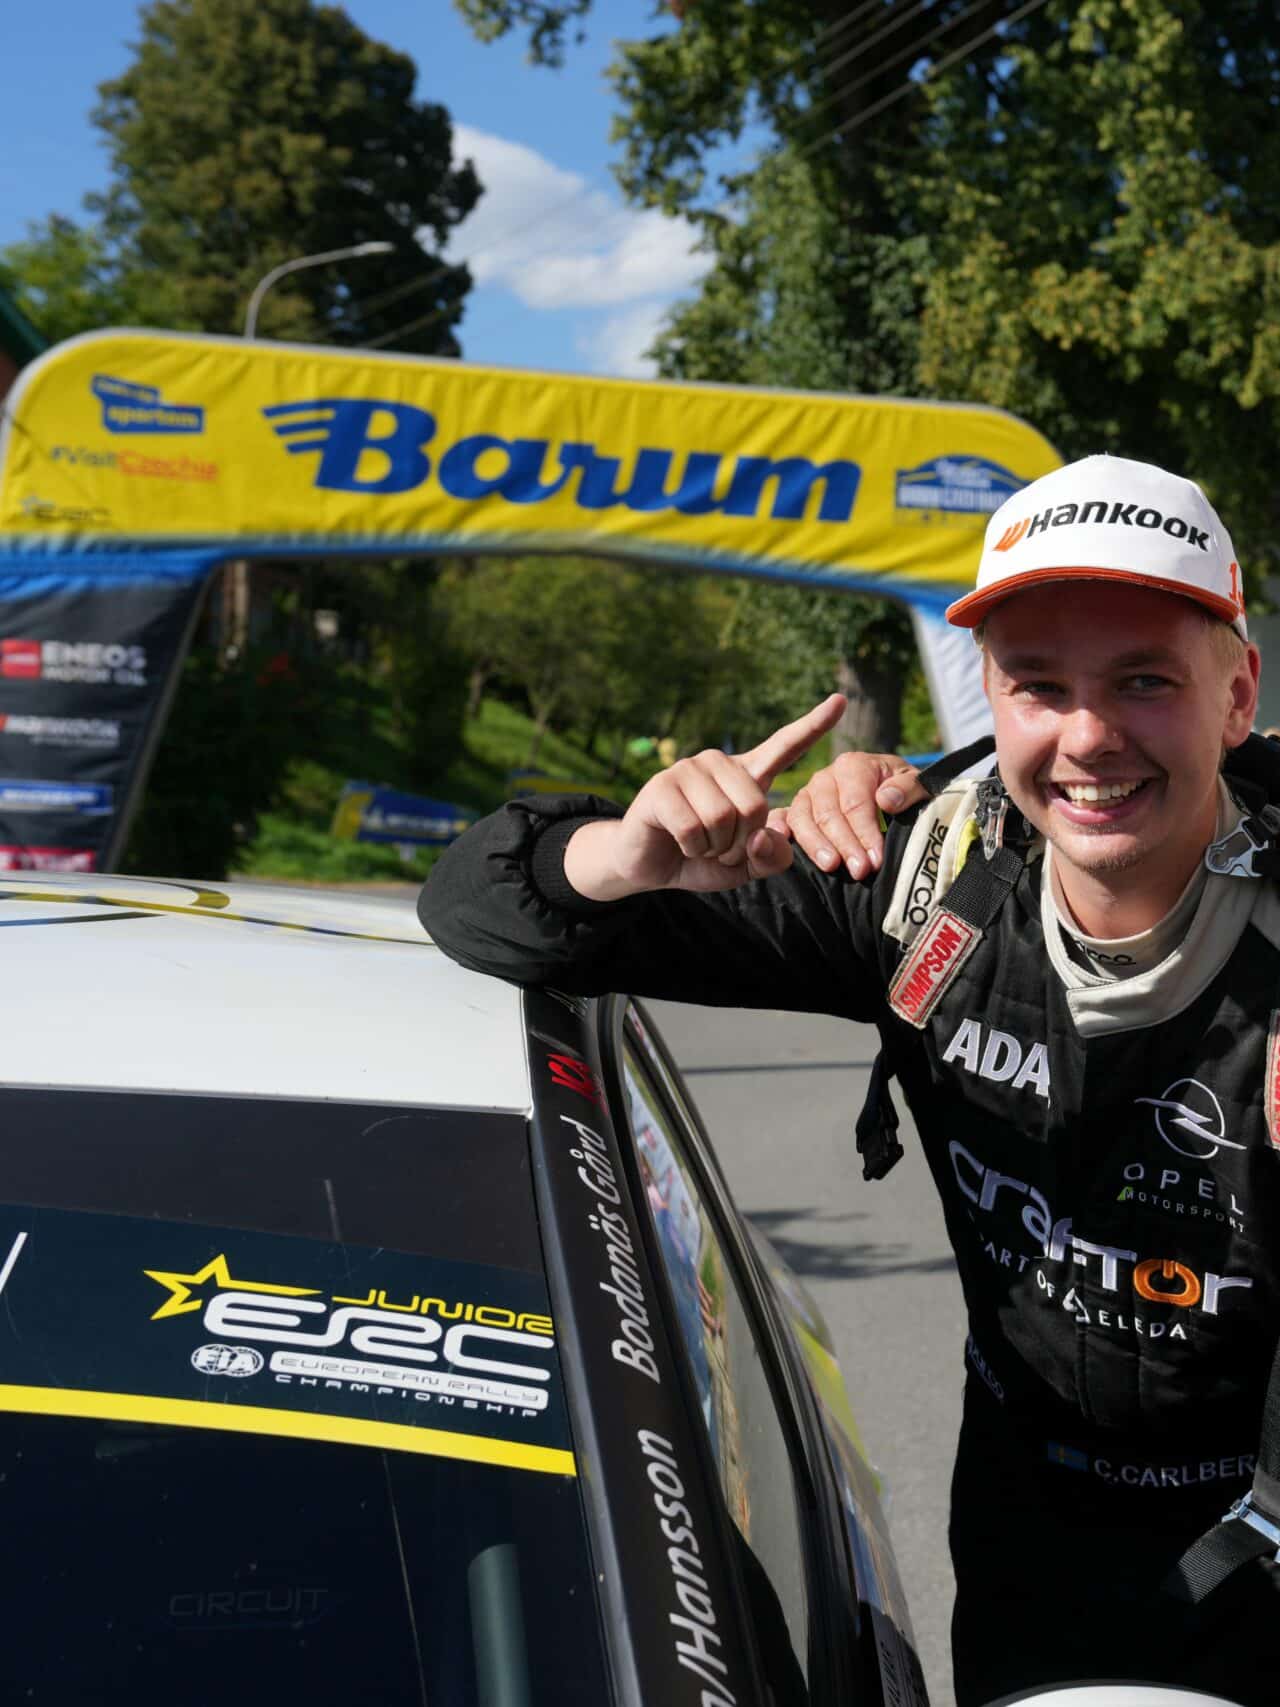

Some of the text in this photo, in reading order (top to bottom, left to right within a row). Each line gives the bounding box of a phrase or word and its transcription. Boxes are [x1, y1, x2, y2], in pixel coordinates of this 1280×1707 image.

[312, 397, 862, 524] Barum
[900, 923, 963, 1014] SIMPSON
[942, 1018, 1050, 1097] ADA
[1123, 1162, 1244, 1216] OPEL
[204, 1291, 555, 1382] ERC
[332, 1288, 554, 1335] JUNIOR
[276, 1373, 537, 1417] CHAMPIONSHIP
[280, 1356, 539, 1402] EUROPEAN RALLY
[1093, 1453, 1256, 1489] C.CARLBER
